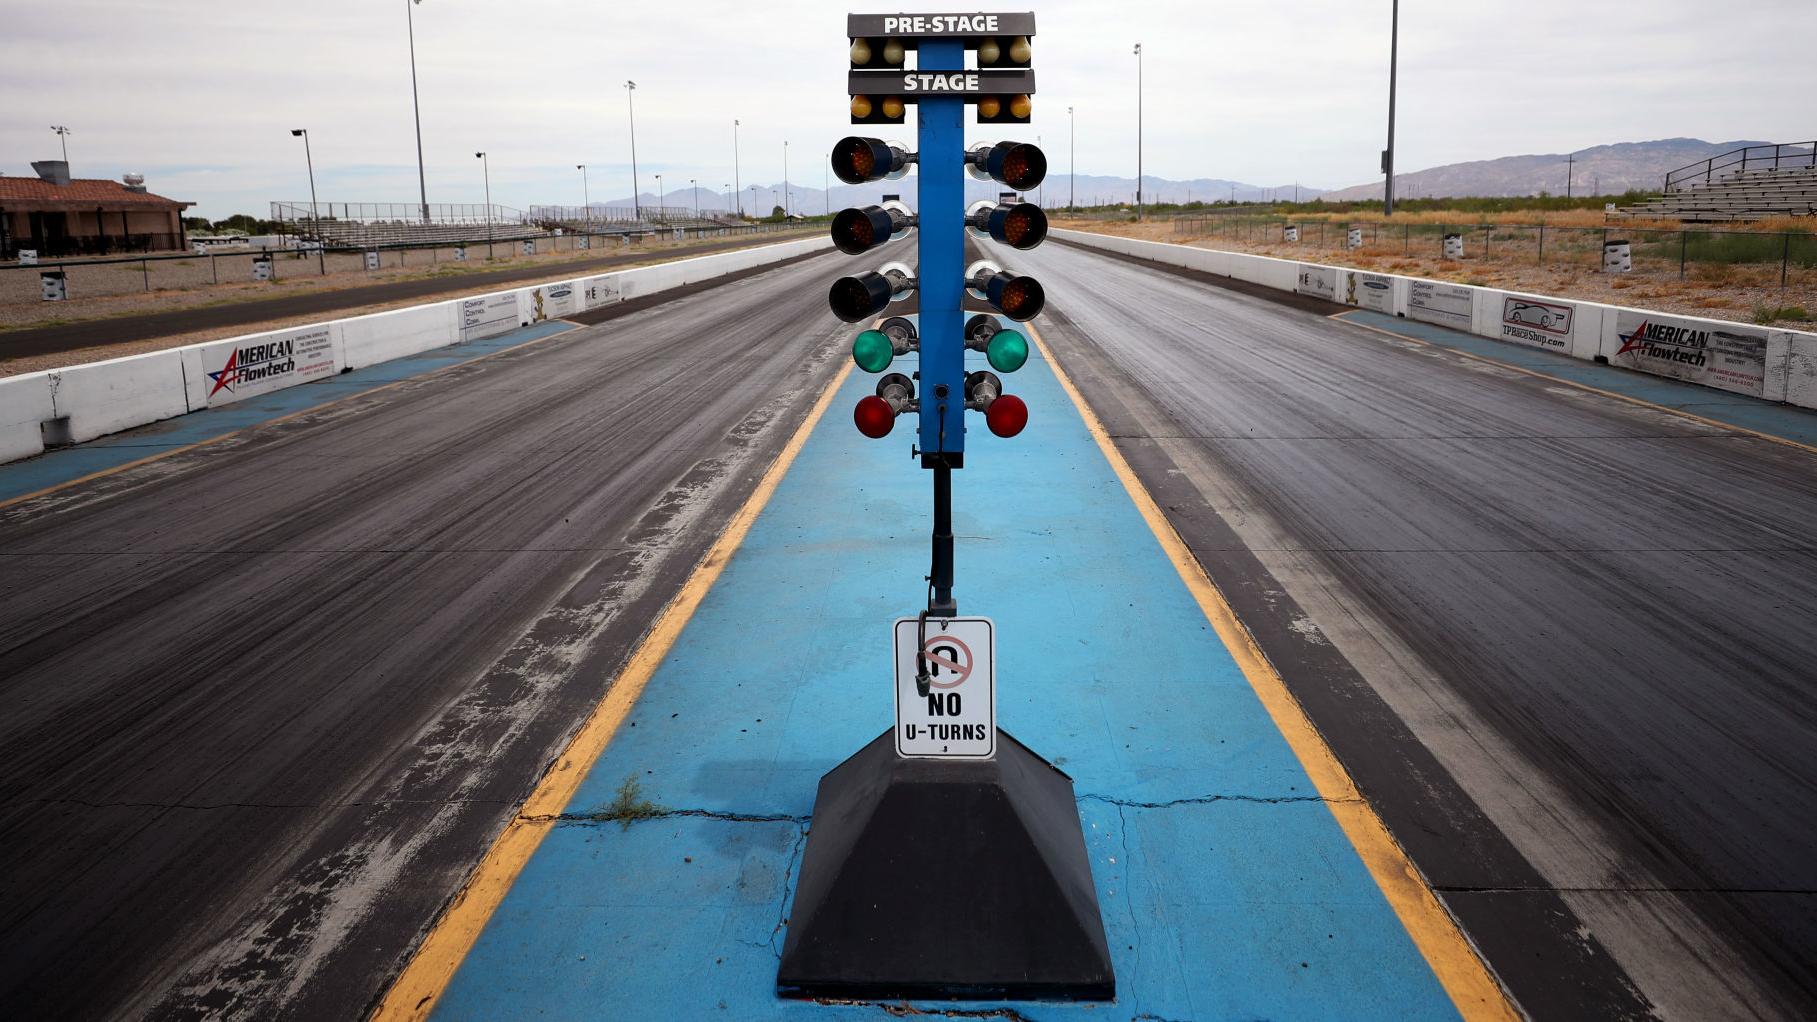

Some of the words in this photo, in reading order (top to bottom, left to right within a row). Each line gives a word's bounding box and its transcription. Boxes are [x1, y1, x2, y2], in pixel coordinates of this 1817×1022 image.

[884, 15, 999, 34] PRE-STAGE
[904, 74, 979, 91] STAGE
[928, 693, 961, 717] NO
[906, 724, 986, 740] U-TURNS
